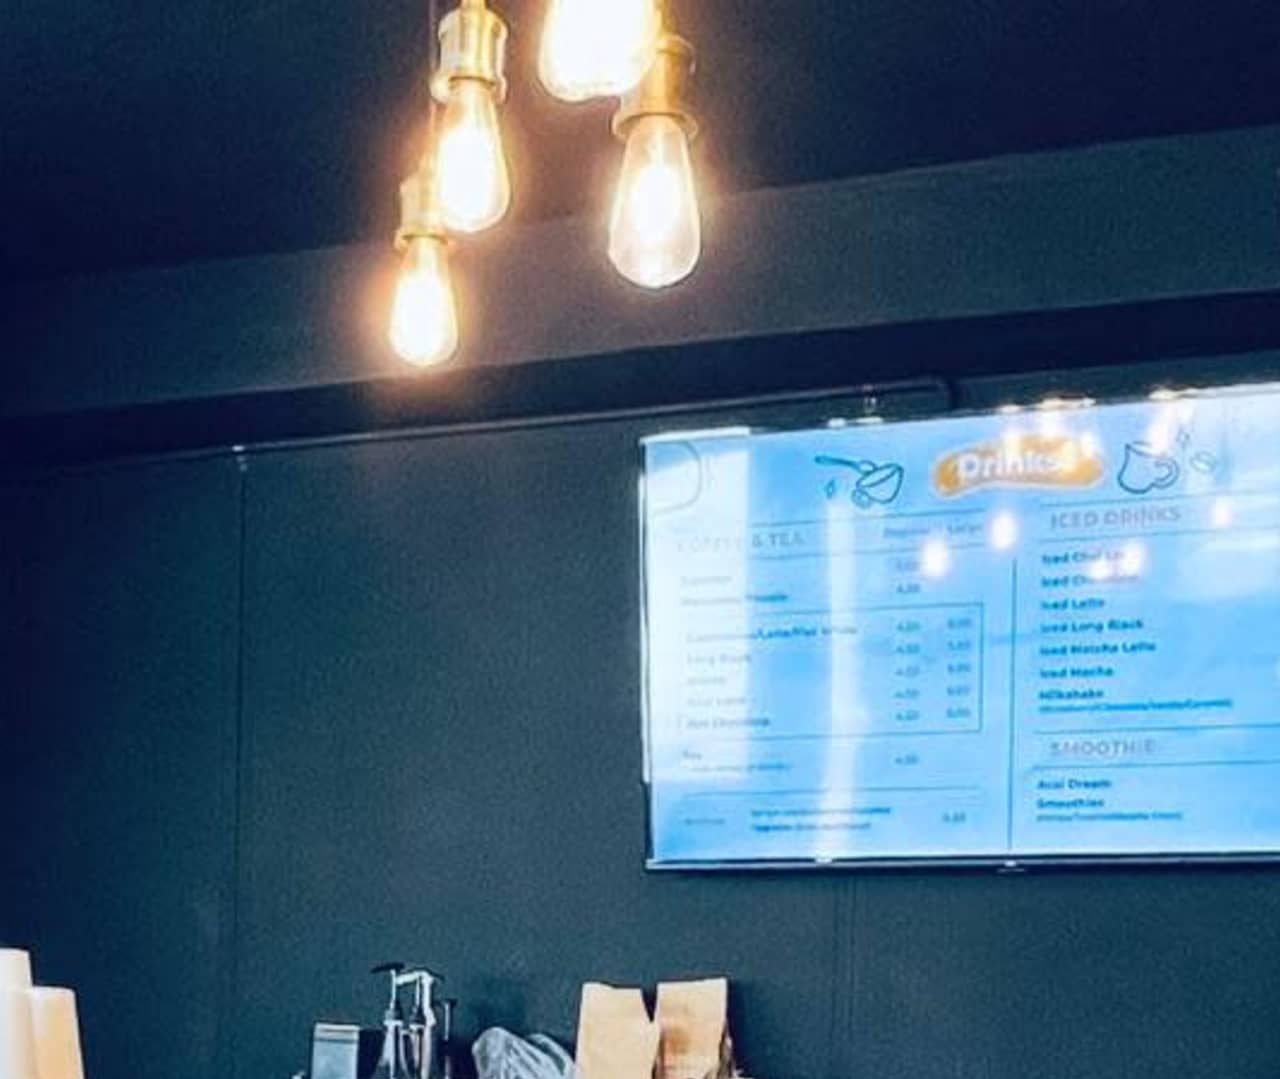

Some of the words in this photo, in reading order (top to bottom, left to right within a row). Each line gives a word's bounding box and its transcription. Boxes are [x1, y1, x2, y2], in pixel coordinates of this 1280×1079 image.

[1051, 511, 1099, 529] ICED
[1103, 504, 1182, 527] DRINKS
[769, 530, 804, 547] TEA
[1050, 738, 1156, 756] SMOOTHIE
